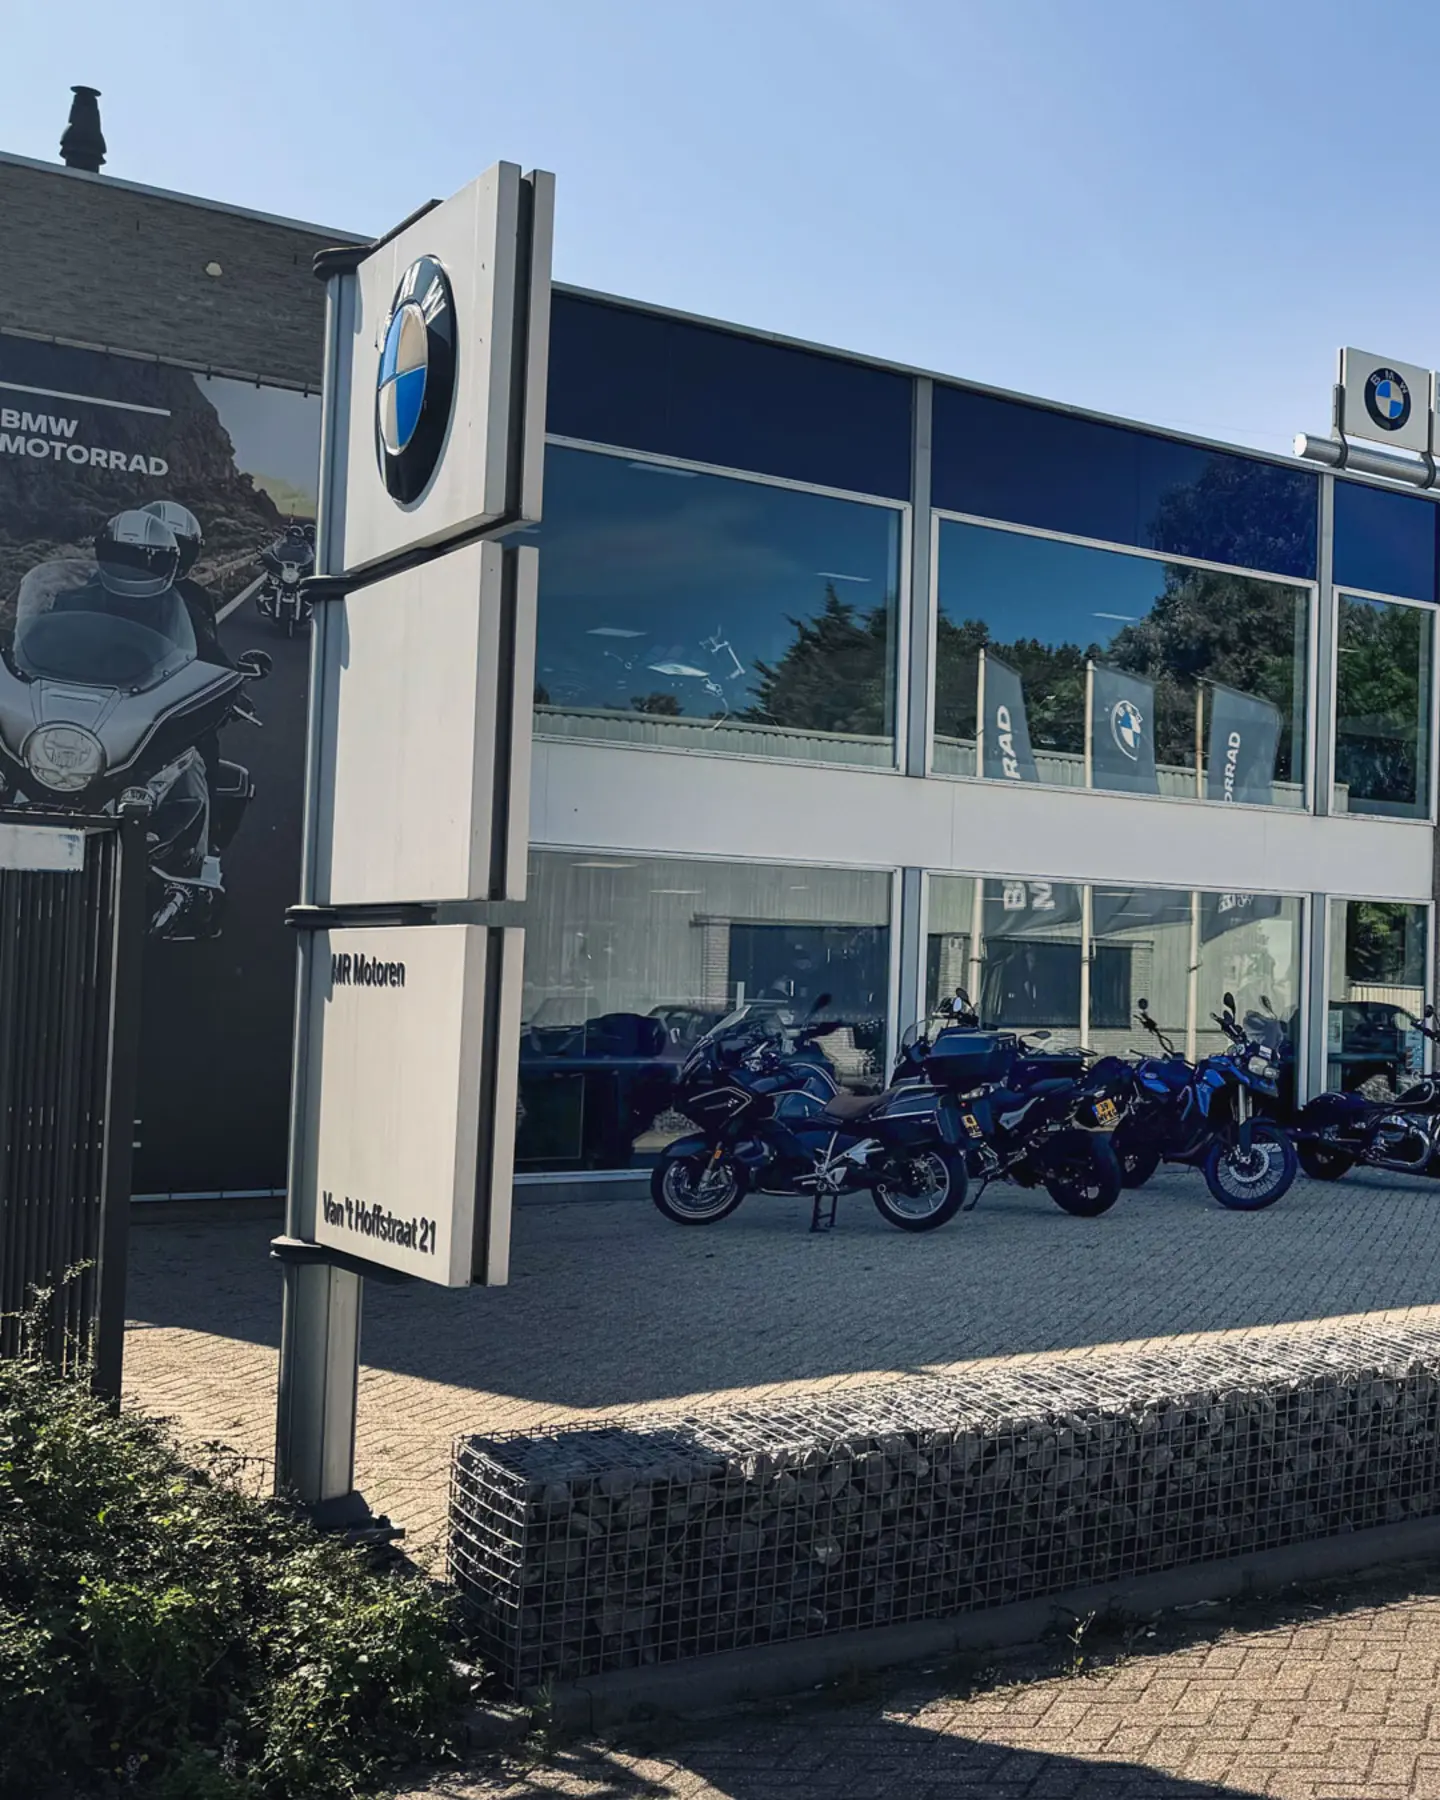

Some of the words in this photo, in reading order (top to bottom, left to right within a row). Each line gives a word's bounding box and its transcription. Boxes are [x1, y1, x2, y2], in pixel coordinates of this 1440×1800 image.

[1370, 370, 1408, 393] BMW
[1, 408, 79, 438] BMW
[0, 433, 169, 477] MOTORRAD
[331, 953, 351, 986] MR
[353, 954, 405, 988] Motoren
[323, 1190, 344, 1228] Van
[355, 1199, 419, 1252] Hoffstraat
[419, 1217, 436, 1255] 21
